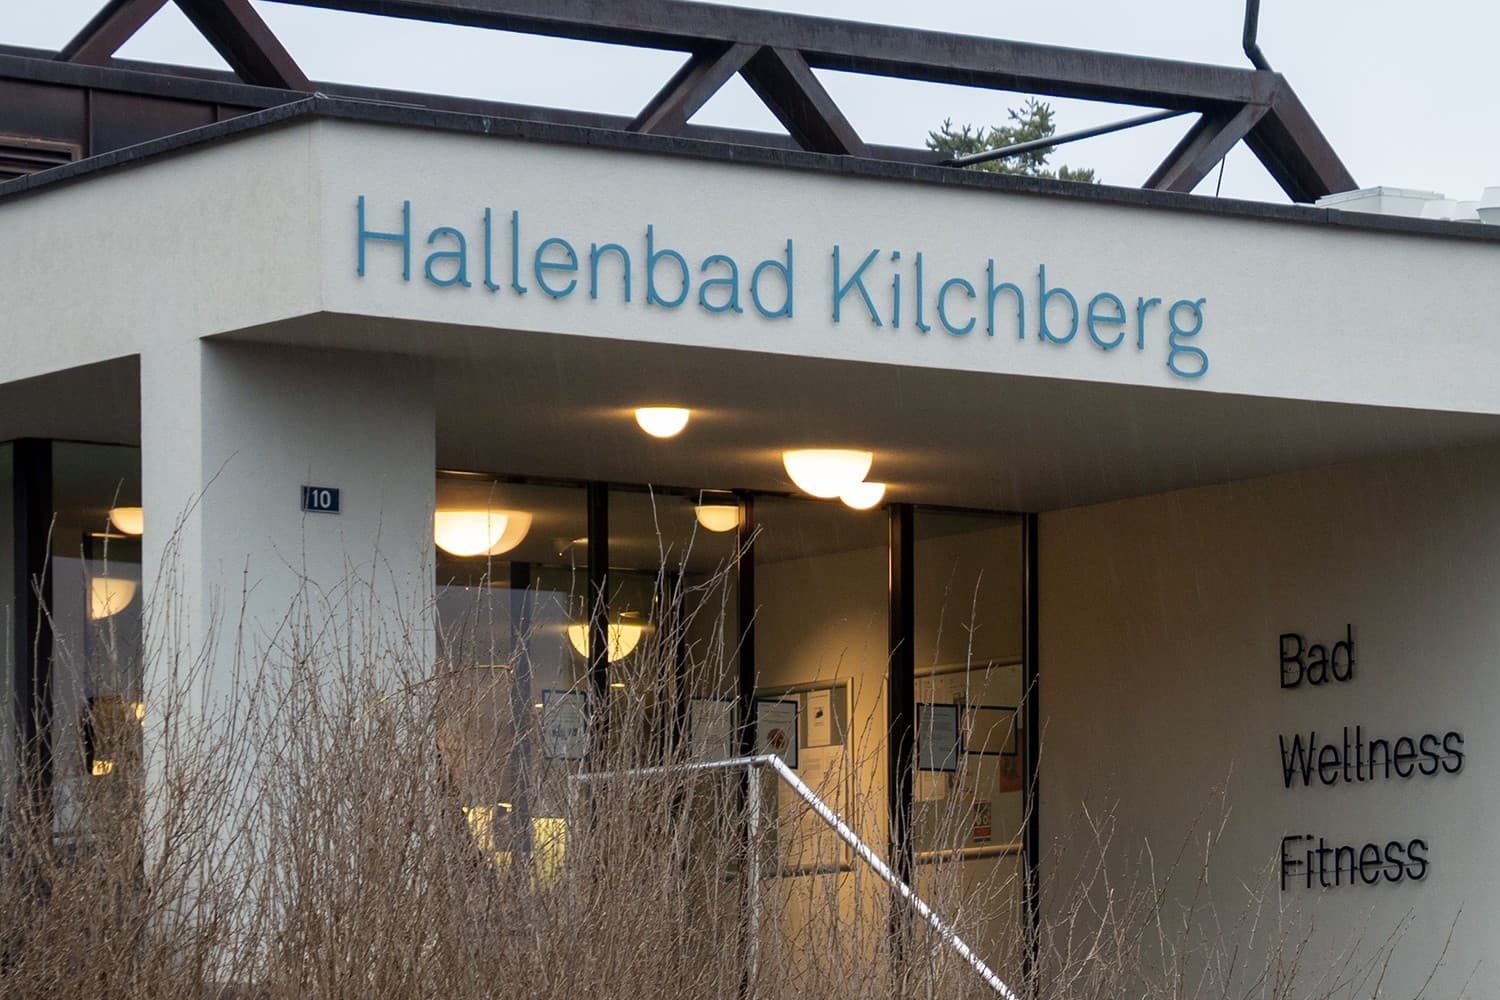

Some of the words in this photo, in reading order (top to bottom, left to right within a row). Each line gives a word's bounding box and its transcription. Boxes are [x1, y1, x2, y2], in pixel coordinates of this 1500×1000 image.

[356, 195, 795, 320] Hallenbad
[831, 244, 1210, 380] Kilchberg
[312, 490, 331, 509] 10
[1279, 623, 1354, 689] Bad
[1279, 725, 1464, 789] Wellness
[1280, 834, 1429, 891] Fitness
